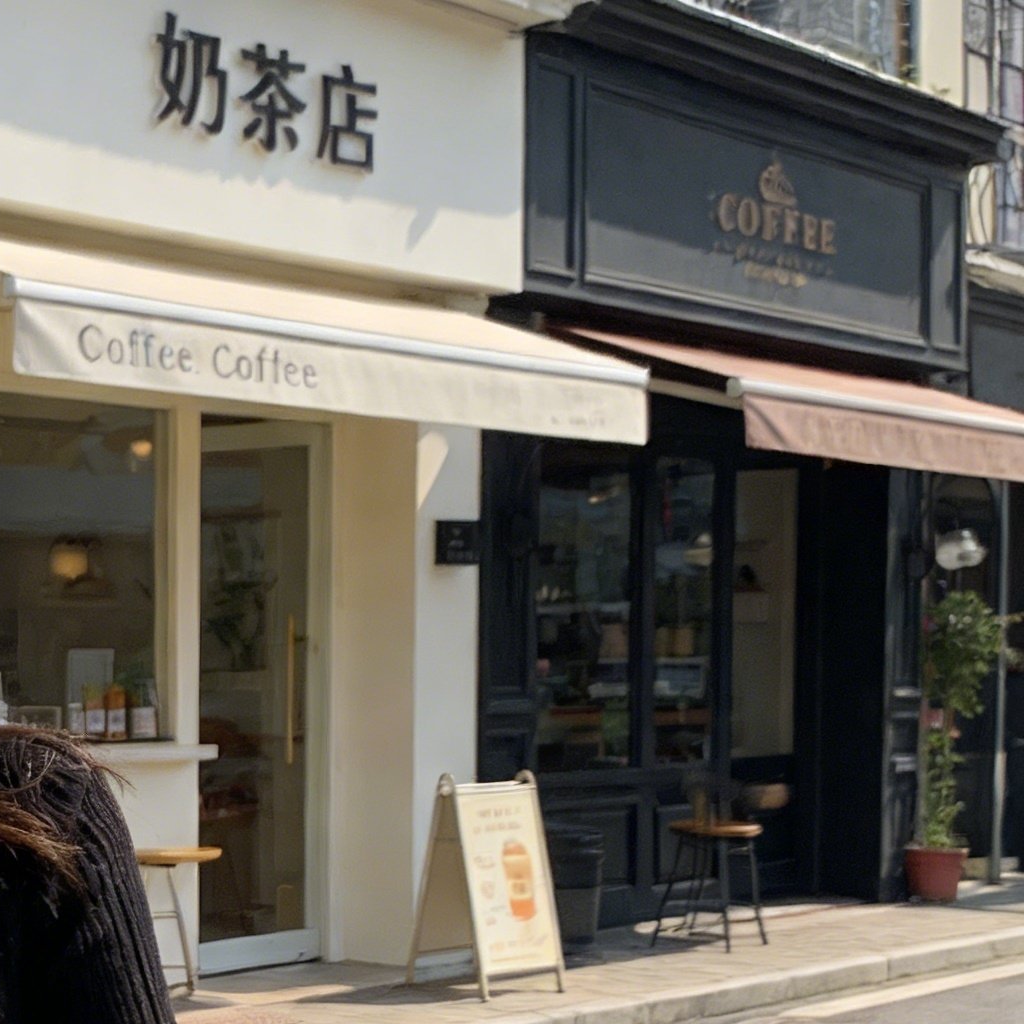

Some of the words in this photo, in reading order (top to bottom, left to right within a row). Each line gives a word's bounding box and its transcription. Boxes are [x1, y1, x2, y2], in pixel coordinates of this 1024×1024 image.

[155, 12, 379, 173] 奶茶店
[719, 193, 836, 254] COFFEE
